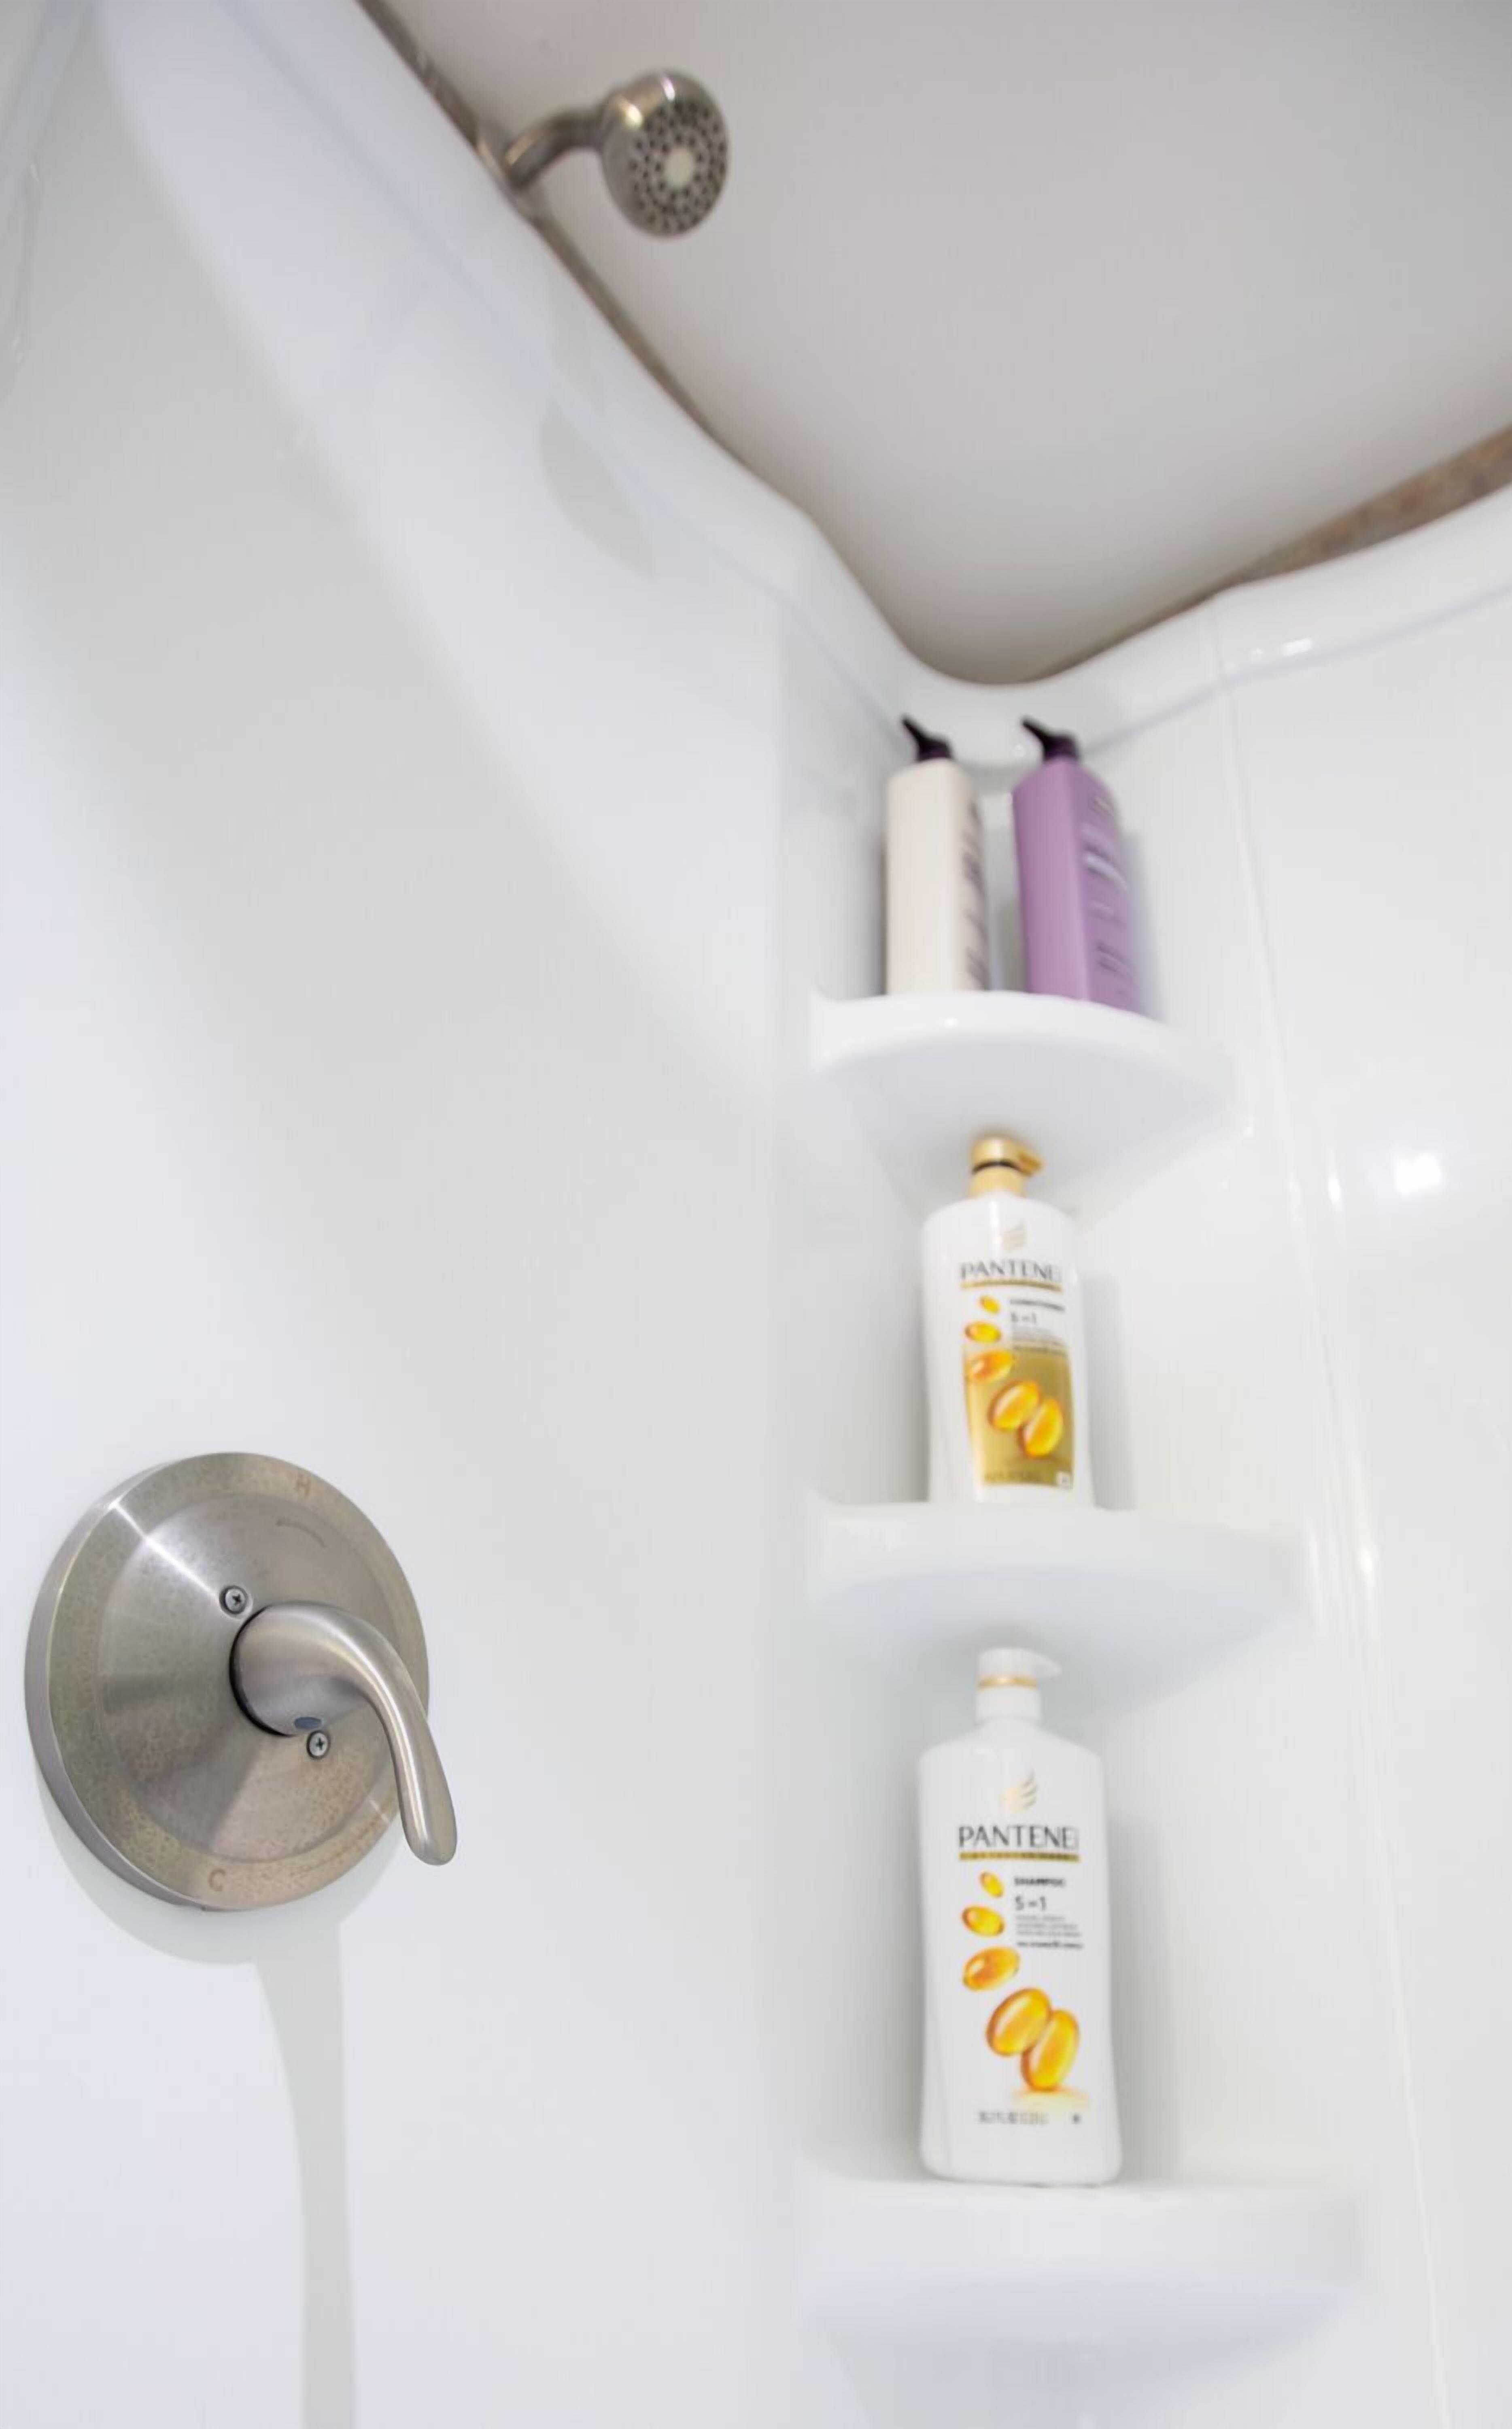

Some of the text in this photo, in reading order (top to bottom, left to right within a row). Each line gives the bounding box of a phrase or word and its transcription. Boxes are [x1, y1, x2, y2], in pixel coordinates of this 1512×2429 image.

[960, 1258, 1062, 1280] PANTENE
[958, 1825, 1079, 1848] PANTENE
[208, 1868, 226, 1892] C
